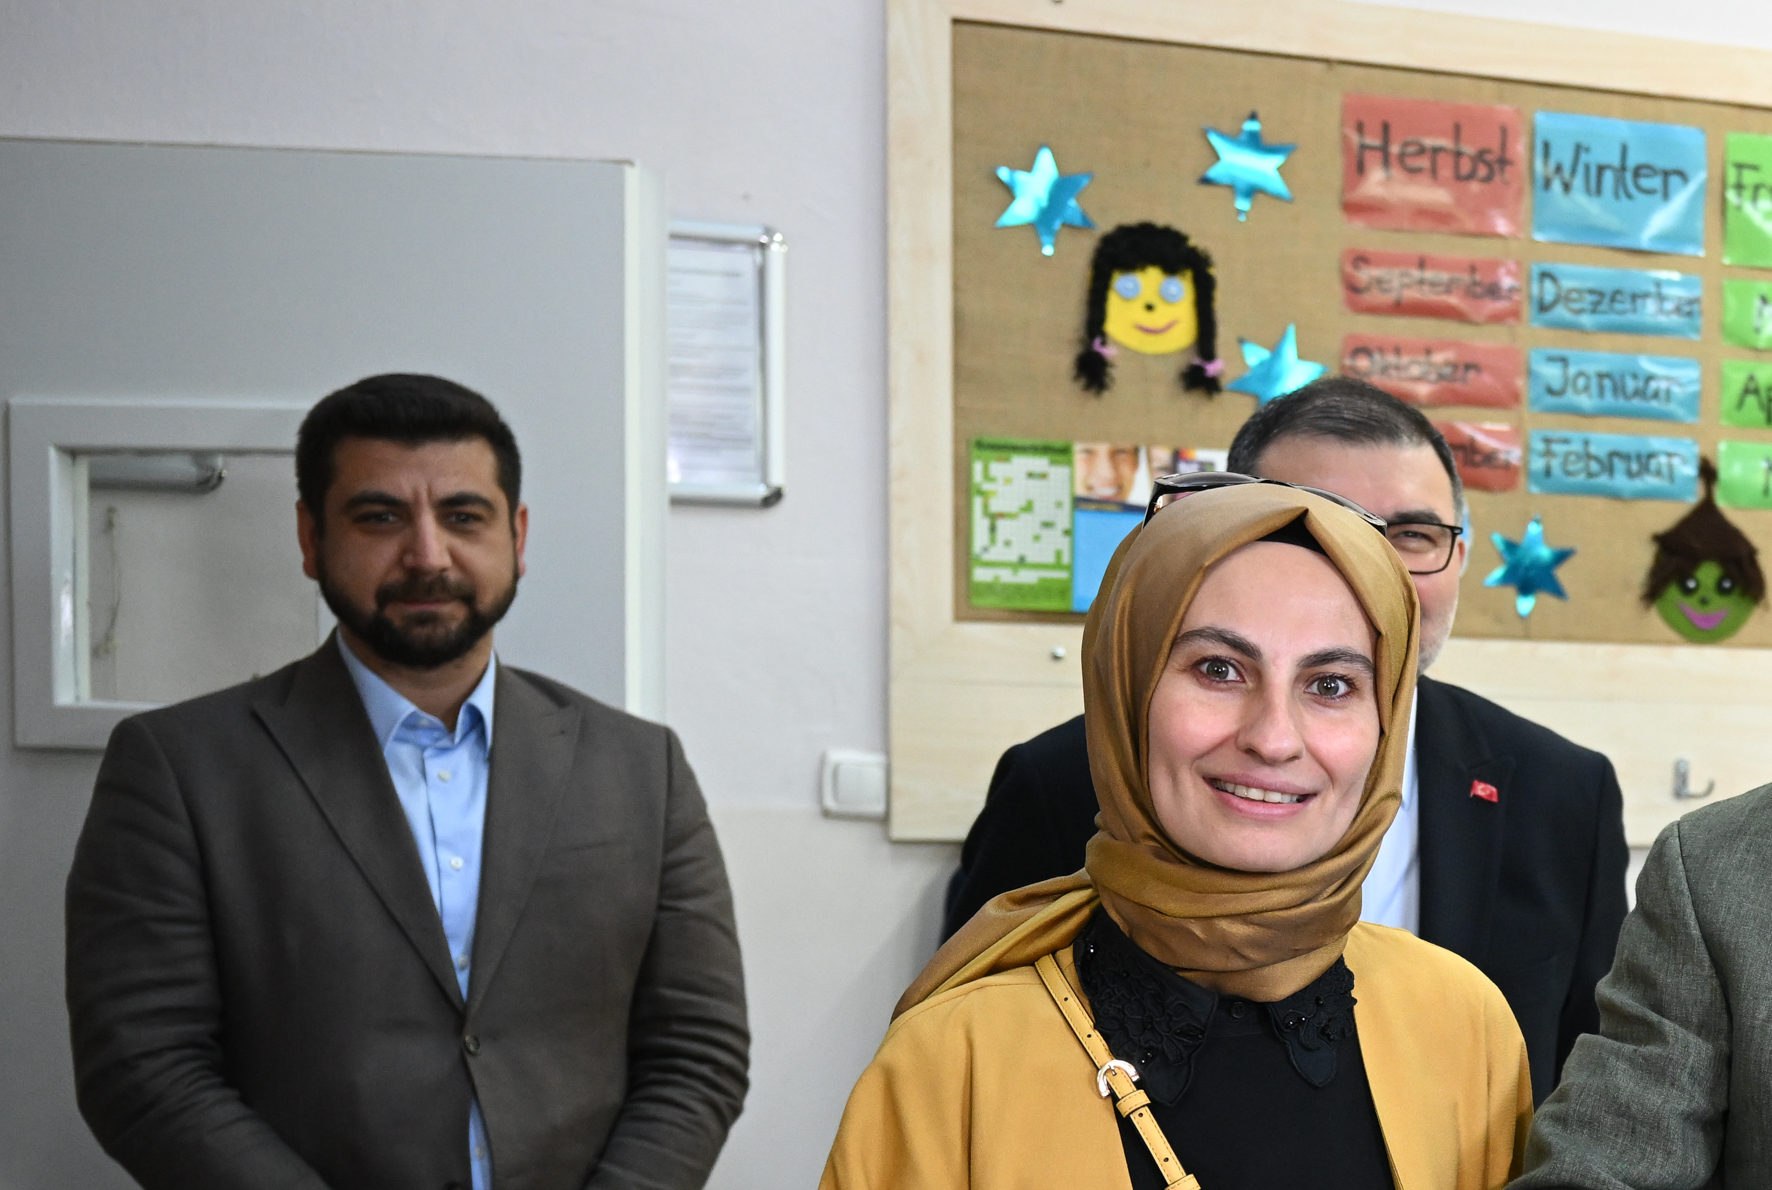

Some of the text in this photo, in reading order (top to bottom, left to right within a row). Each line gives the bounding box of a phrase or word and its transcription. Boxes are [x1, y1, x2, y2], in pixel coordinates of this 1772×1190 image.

[1353, 118, 1514, 185] Herbst
[1540, 138, 1690, 201] Winter
[1544, 355, 1681, 404] Januar
[1539, 436, 1687, 486] Februar
